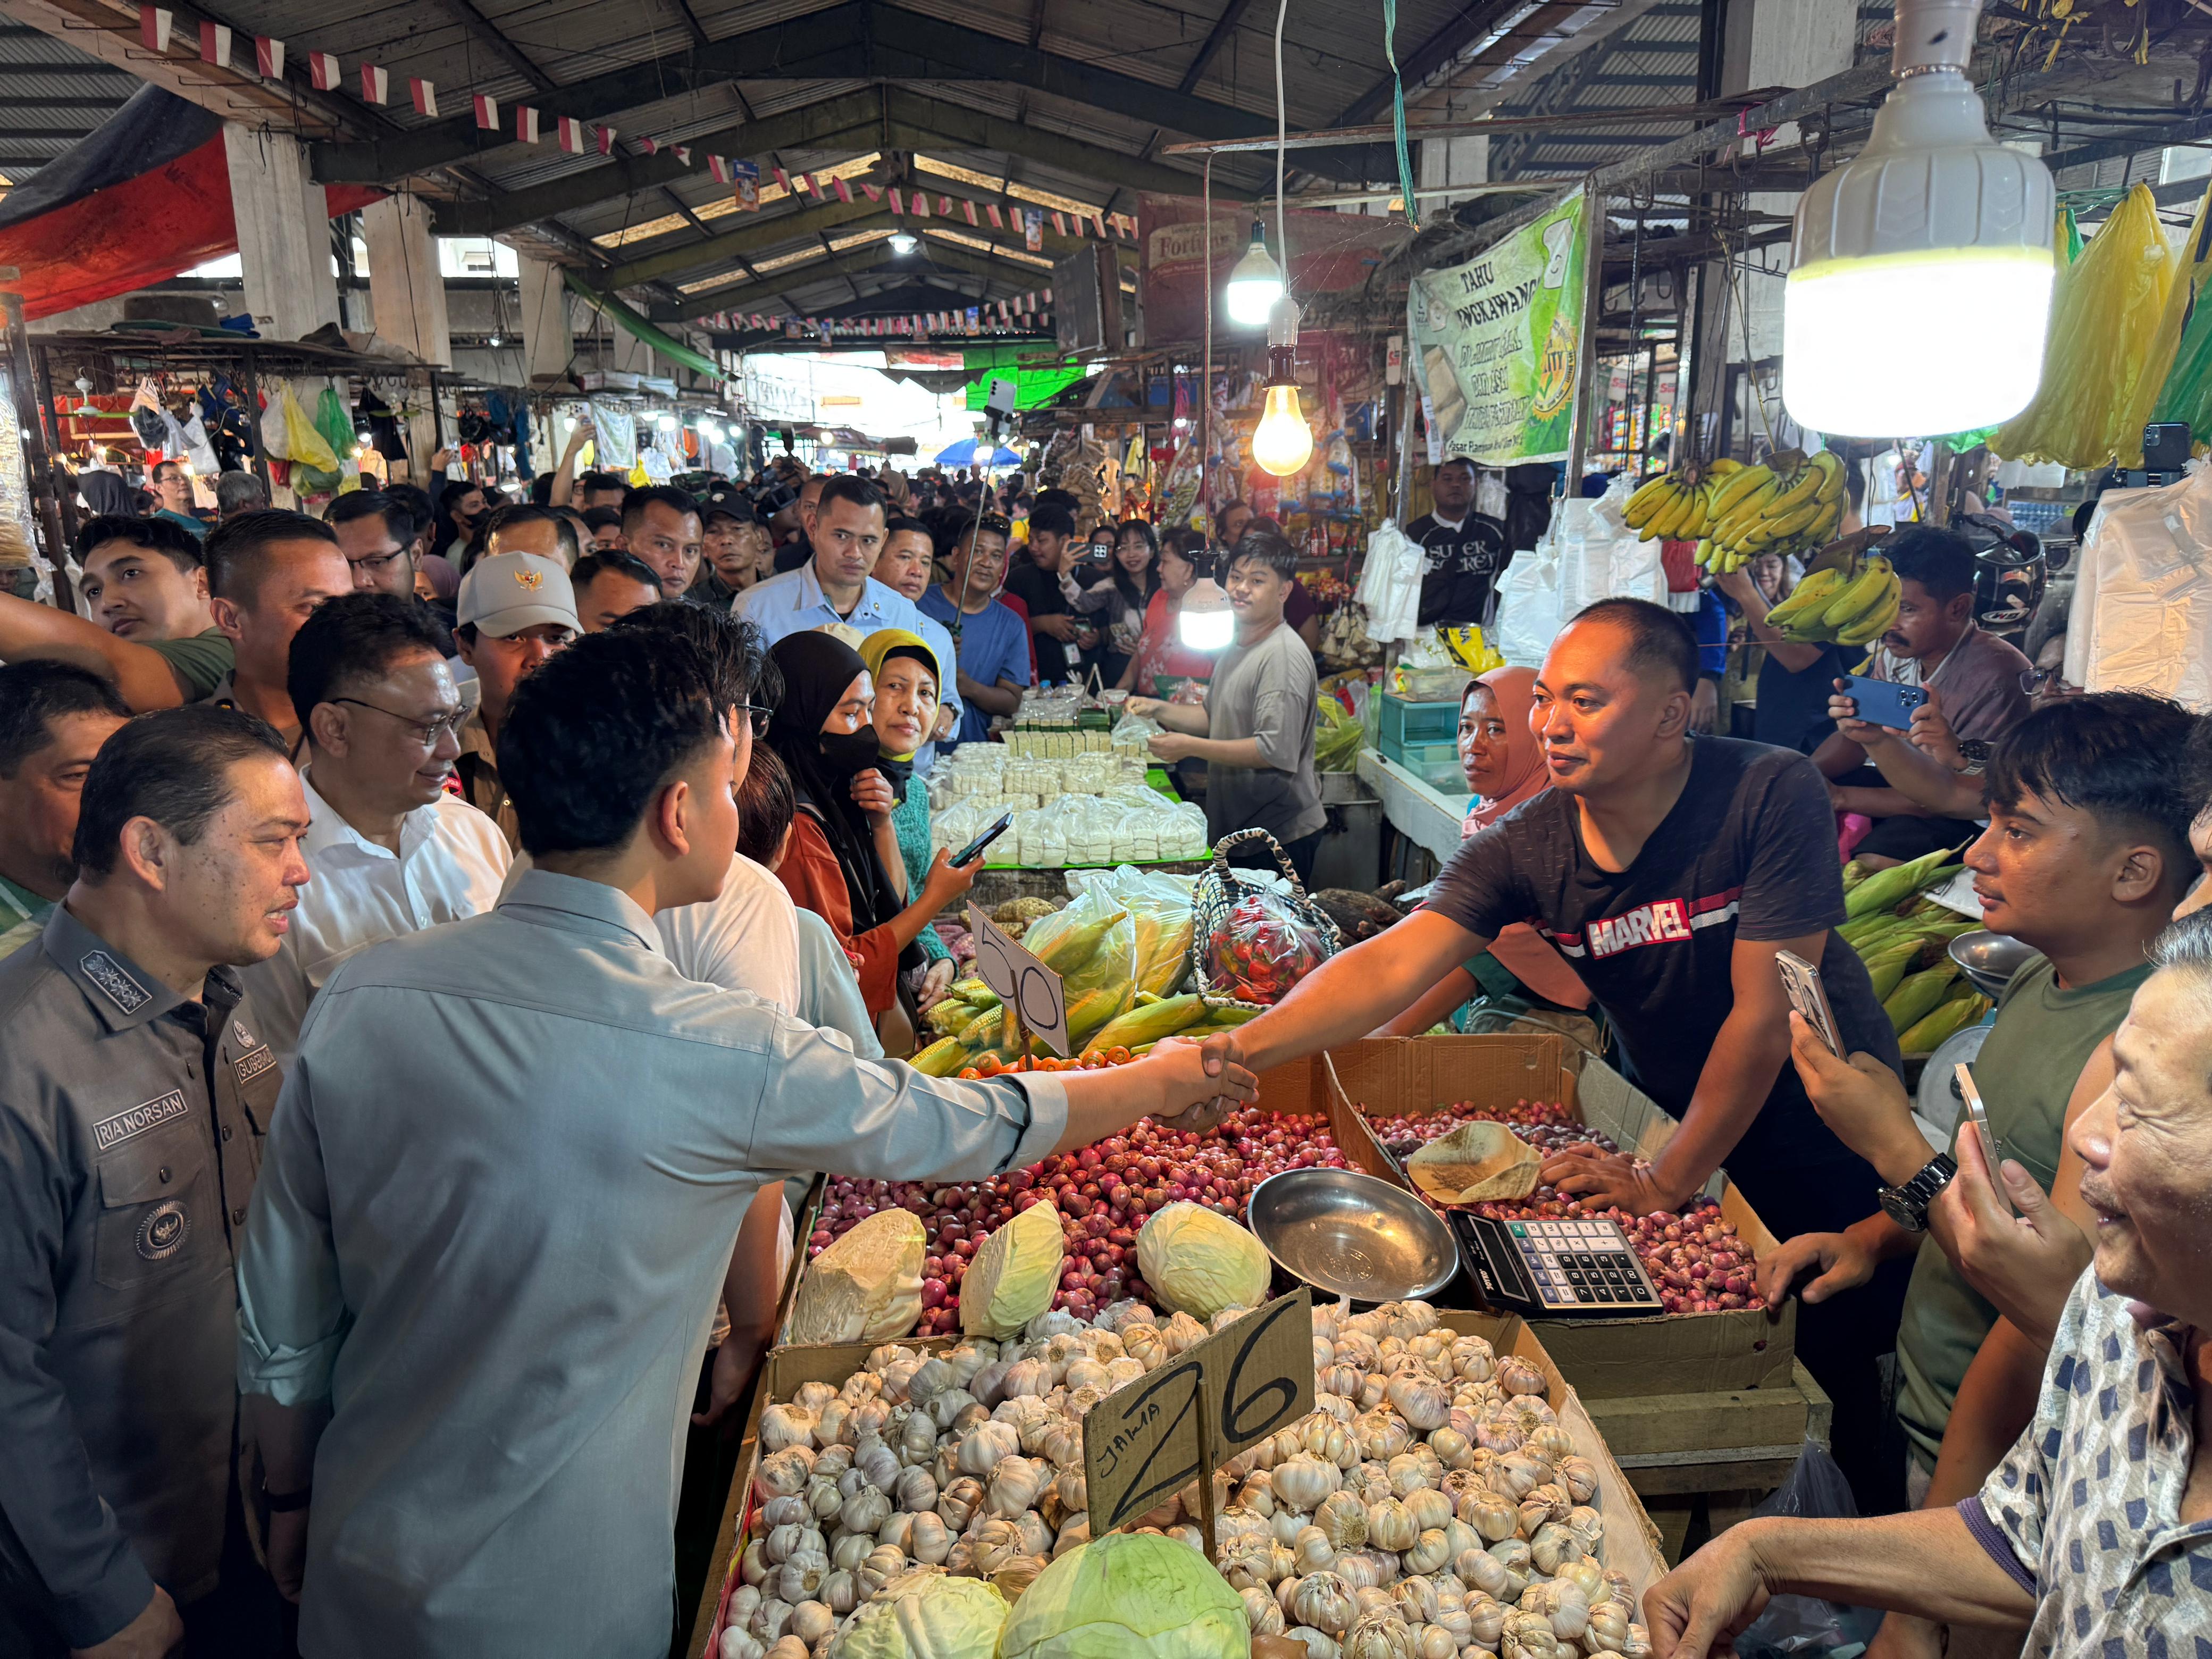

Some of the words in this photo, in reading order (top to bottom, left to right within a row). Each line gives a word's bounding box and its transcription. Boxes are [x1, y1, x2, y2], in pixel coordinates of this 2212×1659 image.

[1460, 262, 1494, 294] TAHU
[1588, 902, 1689, 956] MARVEL
[981, 921, 1058, 1030] 50
[99, 1120, 124, 1143] RIA
[123, 1094, 182, 1133] NORSAN
